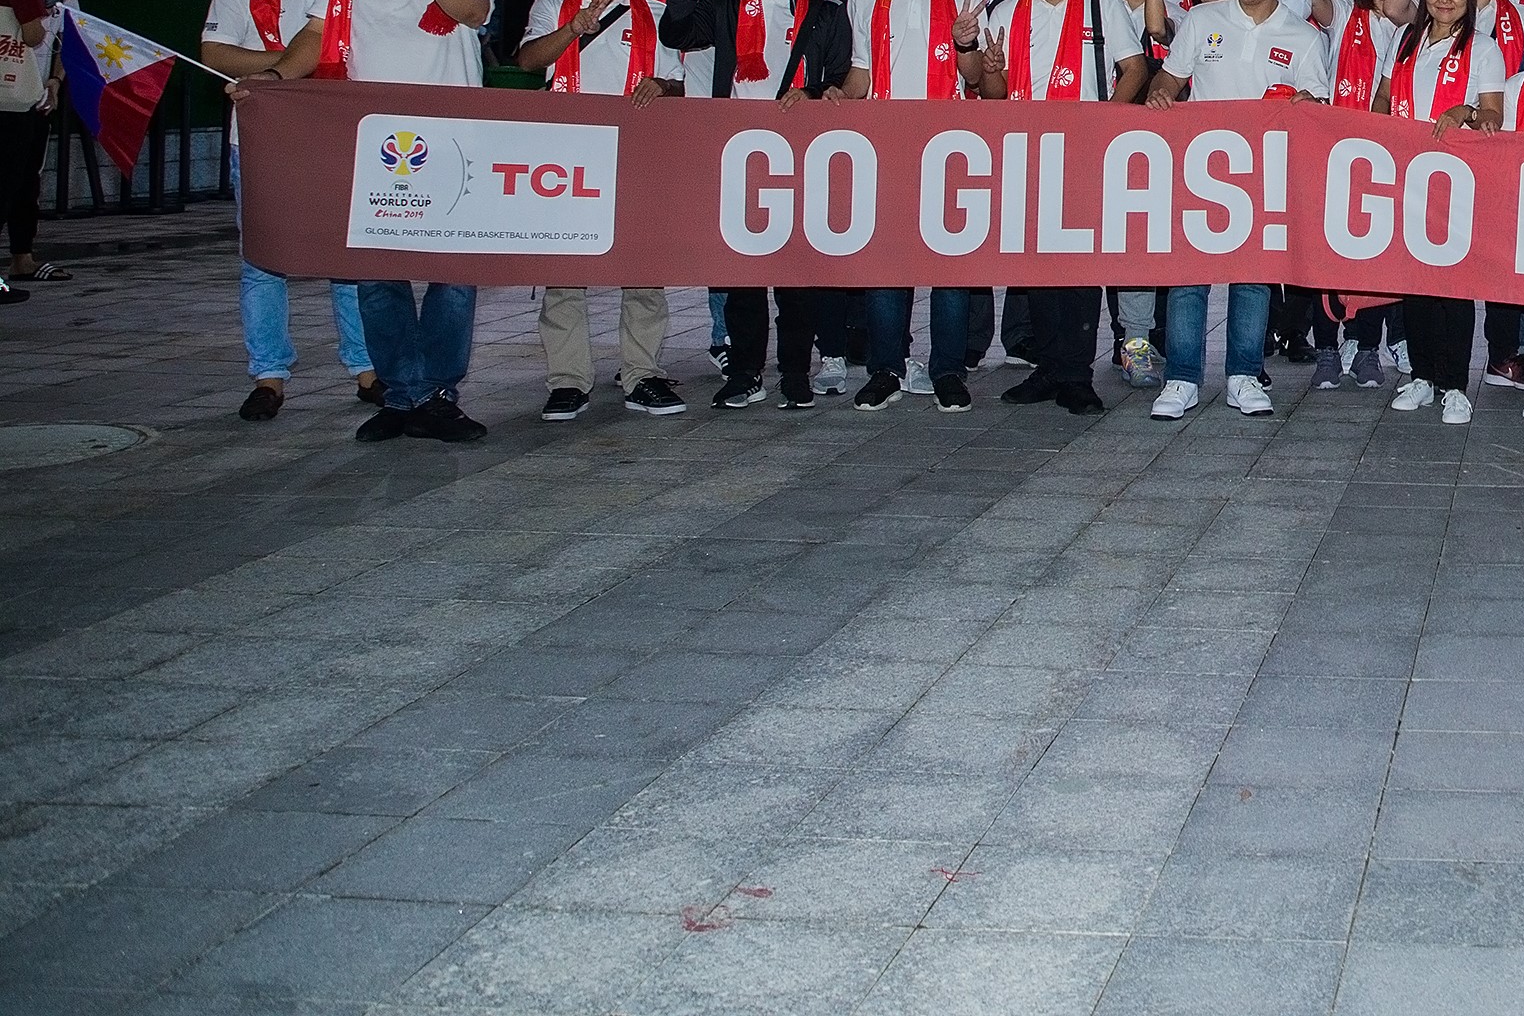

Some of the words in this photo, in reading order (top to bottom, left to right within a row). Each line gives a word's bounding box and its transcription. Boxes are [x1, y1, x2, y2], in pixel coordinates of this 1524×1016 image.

[1500, 12, 1514, 45] TCL
[1273, 51, 1289, 61] TCL
[1442, 50, 1462, 85] TCL
[492, 163, 600, 198] TCL
[369, 197, 408, 207] WORLD
[410, 199, 432, 208] CUP
[719, 129, 878, 257] GO
[918, 129, 1289, 257] GILAS!
[1323, 137, 1477, 267] GO
[375, 209, 402, 218] China
[404, 210, 424, 219] 2019
[365, 227, 400, 236] GLOBAL
[402, 229, 442, 238] PARTNER
[444, 230, 456, 238] OF
[477, 230, 529, 239] BASKETBALL
[531, 232, 561, 240] WORLD
[562, 232, 579, 240] CUP
[580, 233, 599, 241] 2019
